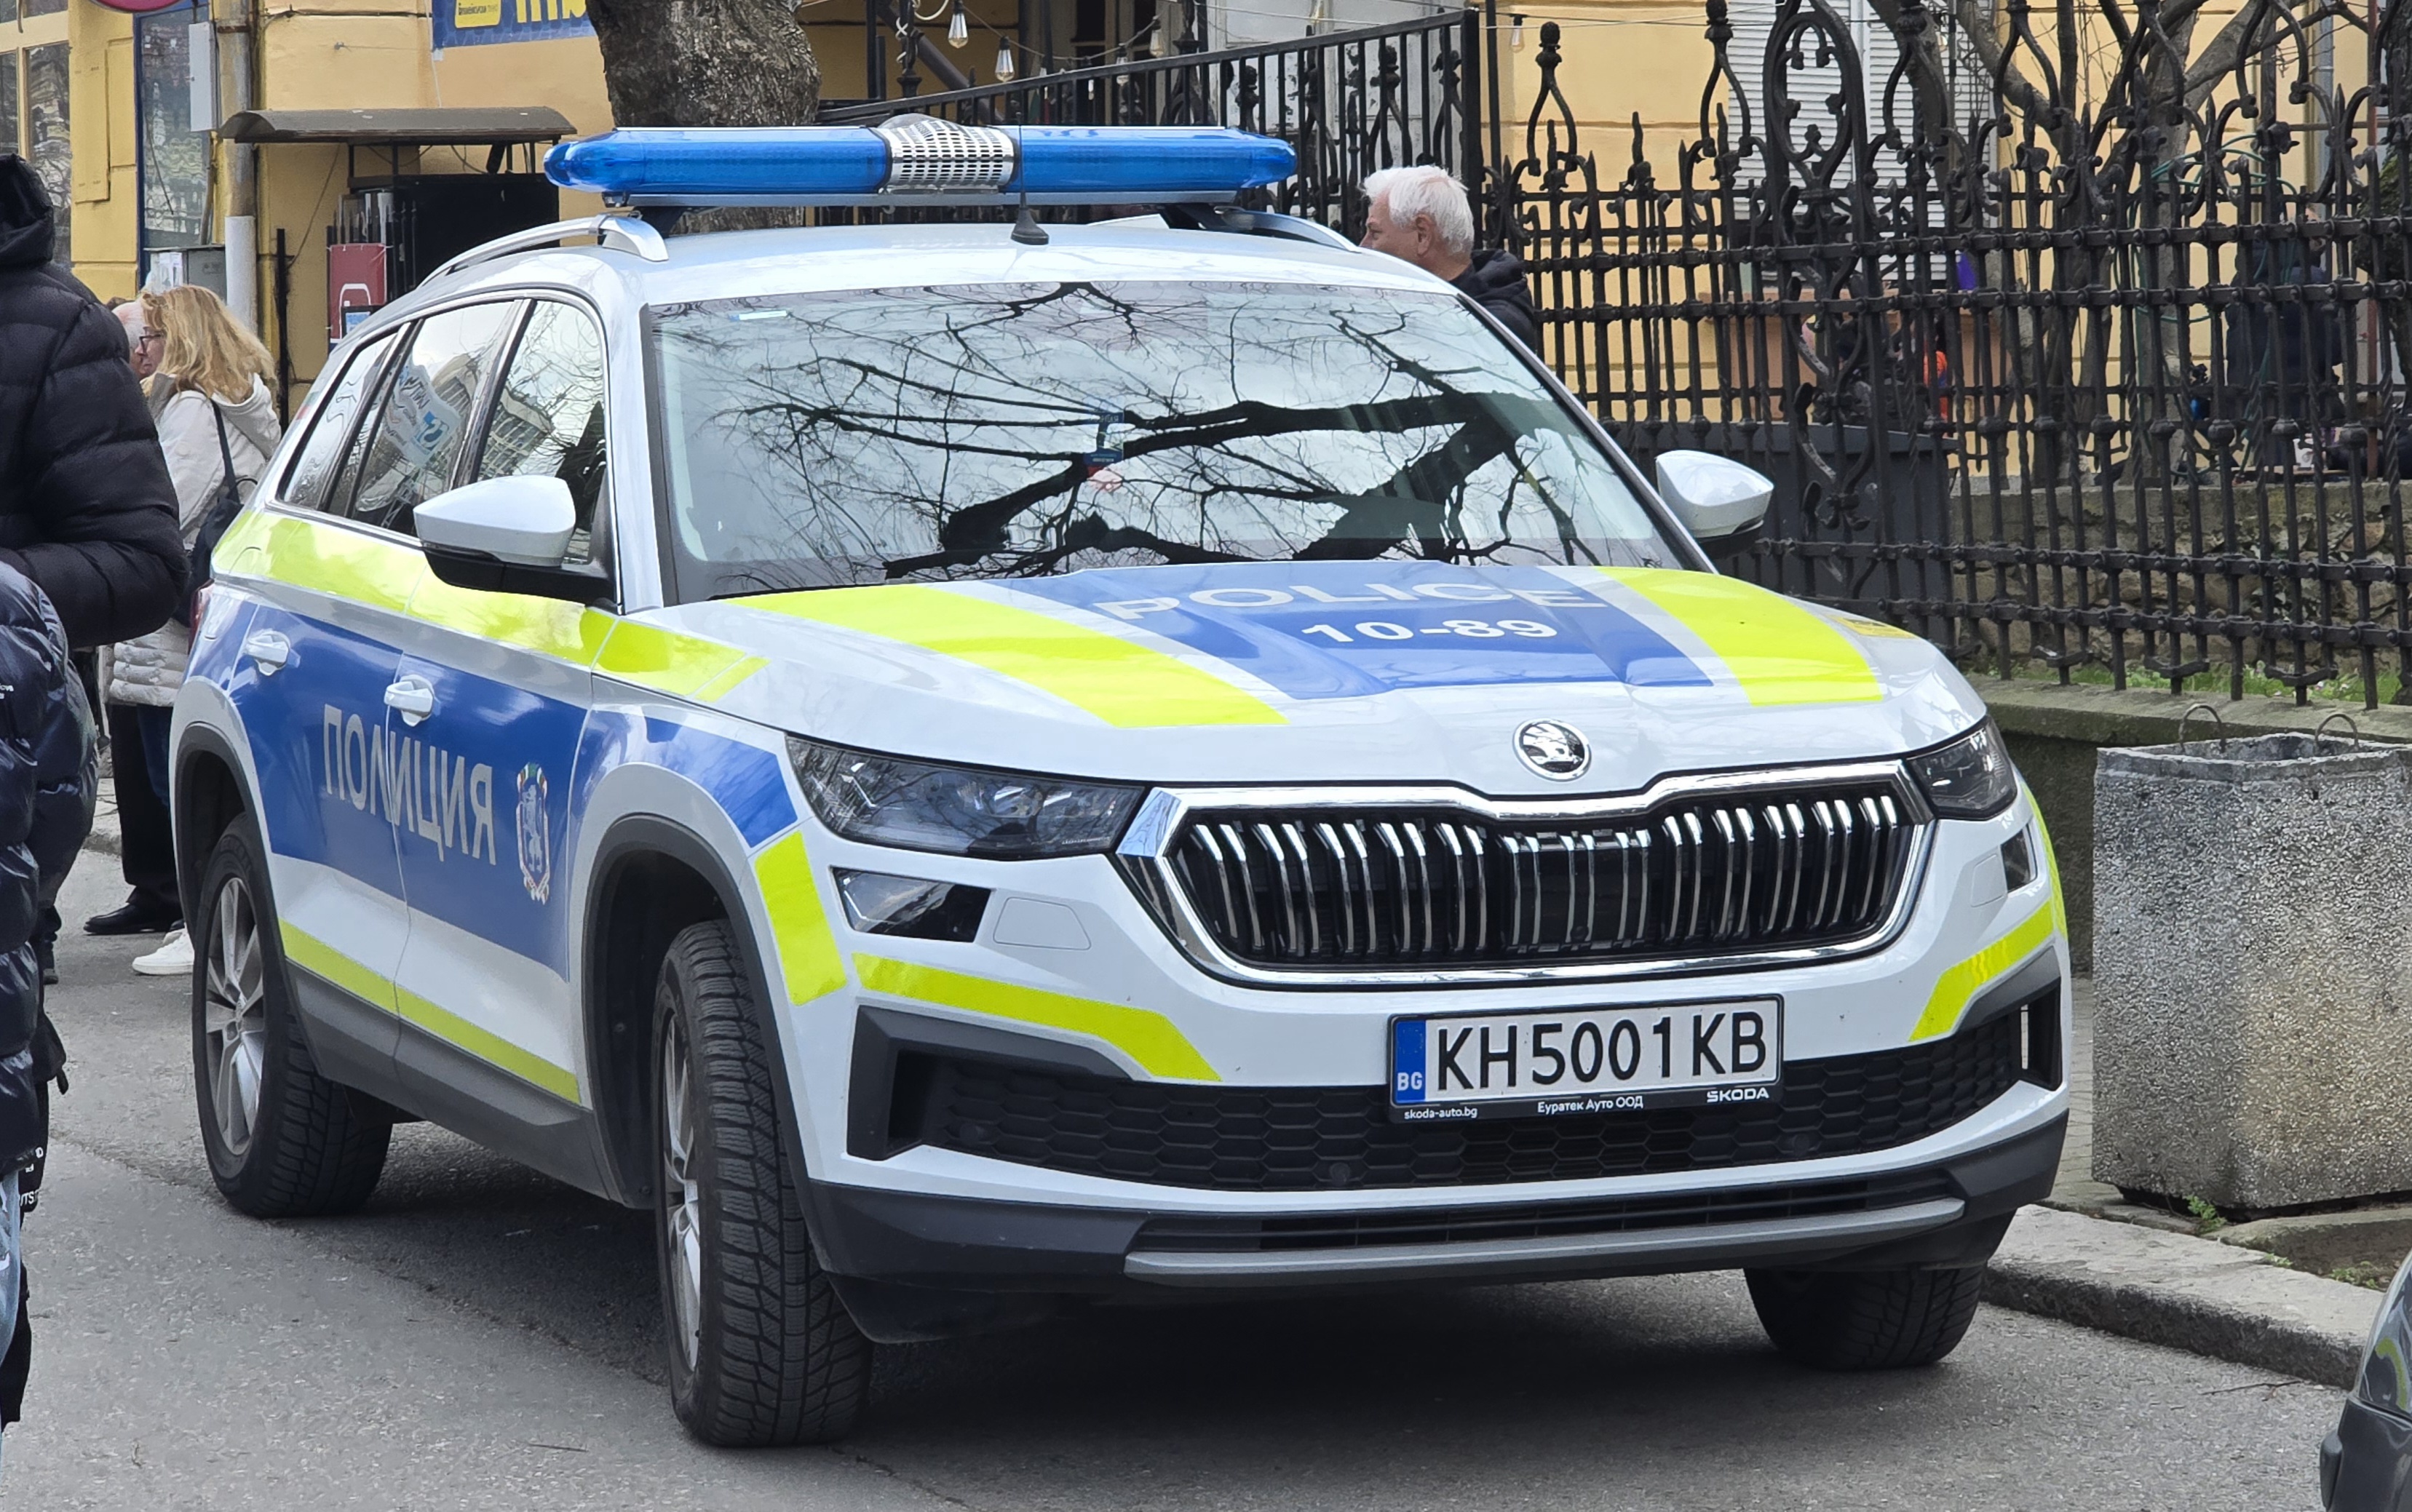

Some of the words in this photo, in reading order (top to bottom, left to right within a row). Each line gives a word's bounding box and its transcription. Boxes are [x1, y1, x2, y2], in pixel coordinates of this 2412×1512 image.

[1094, 582, 1608, 621] POLICE
[1302, 619, 1558, 643] 10-89
[324, 703, 496, 866] ПОЛИЦИЯ
[1397, 1072, 1423, 1091] BG
[1404, 1105, 1478, 1120] skoda-auto.bg
[1585, 1098, 1614, 1113] Ауто
[1615, 1095, 1644, 1110] ООД
